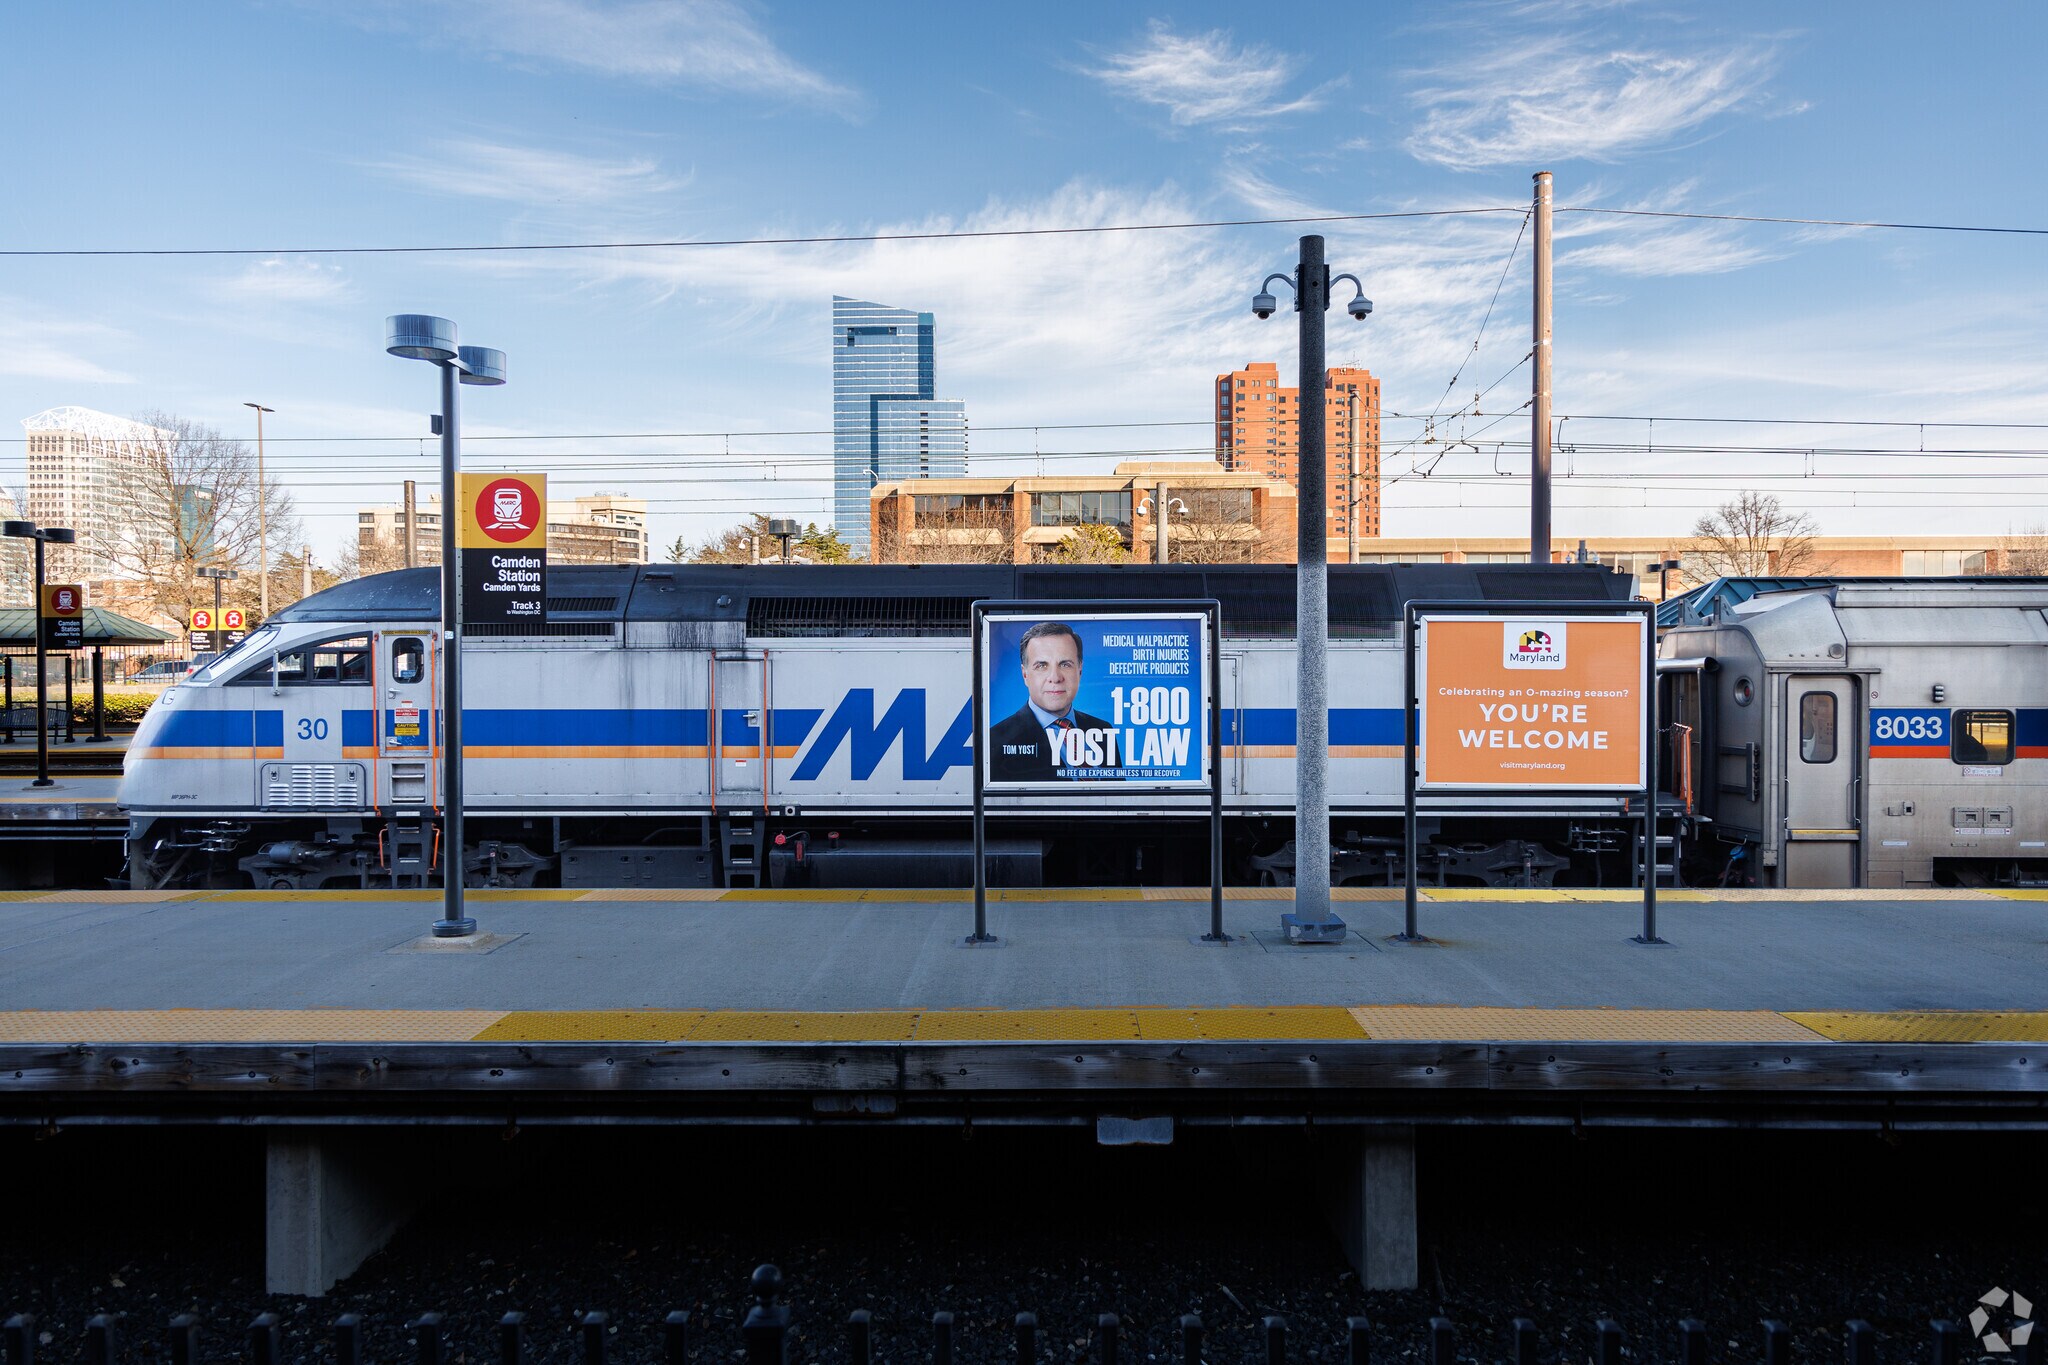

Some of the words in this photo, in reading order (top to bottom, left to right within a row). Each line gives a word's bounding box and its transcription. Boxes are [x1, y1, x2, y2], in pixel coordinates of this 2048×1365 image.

[491, 555, 541, 568] Camden
[498, 569, 541, 582] Station
[483, 582, 516, 592] Camden
[517, 582, 541, 592] Yards
[511, 601, 534, 610] Track
[535, 601, 541, 610] 3
[1103, 635, 1135, 647] MEDICAL
[1137, 635, 1189, 647] MALPRACTICE
[1133, 649, 1155, 661] BIRTH
[1157, 649, 1189, 661] INJURIES
[1509, 653, 1560, 664] Maryland
[1109, 662, 1148, 675] DEFECTIVE
[1150, 662, 1189, 675] PRODUCTS
[1438, 687, 1505, 698] Celebrating
[1508, 689, 1522, 697] an
[1526, 688, 1581, 698] O-mazing
[1584, 689, 1629, 698] season?
[1111, 686, 1190, 725] 1-800
[297, 718, 329, 740] 30
[1876, 716, 1943, 739] 8033
[1458, 729, 1608, 750] WELCOME
[1002, 744, 1017, 755] TOM
[1018, 744, 1035, 755] YOST
[1046, 728, 1120, 766] YOST
[1125, 728, 1191, 766] LAW
[1500, 761, 1566, 770] visitmaryland.org
[1056, 769, 1066, 777] NO
[1067, 769, 1077, 777] FEE
[1079, 769, 1087, 777] OR
[1088, 769, 1115, 777] EXPENSE
[1116, 769, 1139, 777] UNLESS
[1140, 769, 1152, 777] YOU
[1153, 769, 1181, 777] RECOVER
